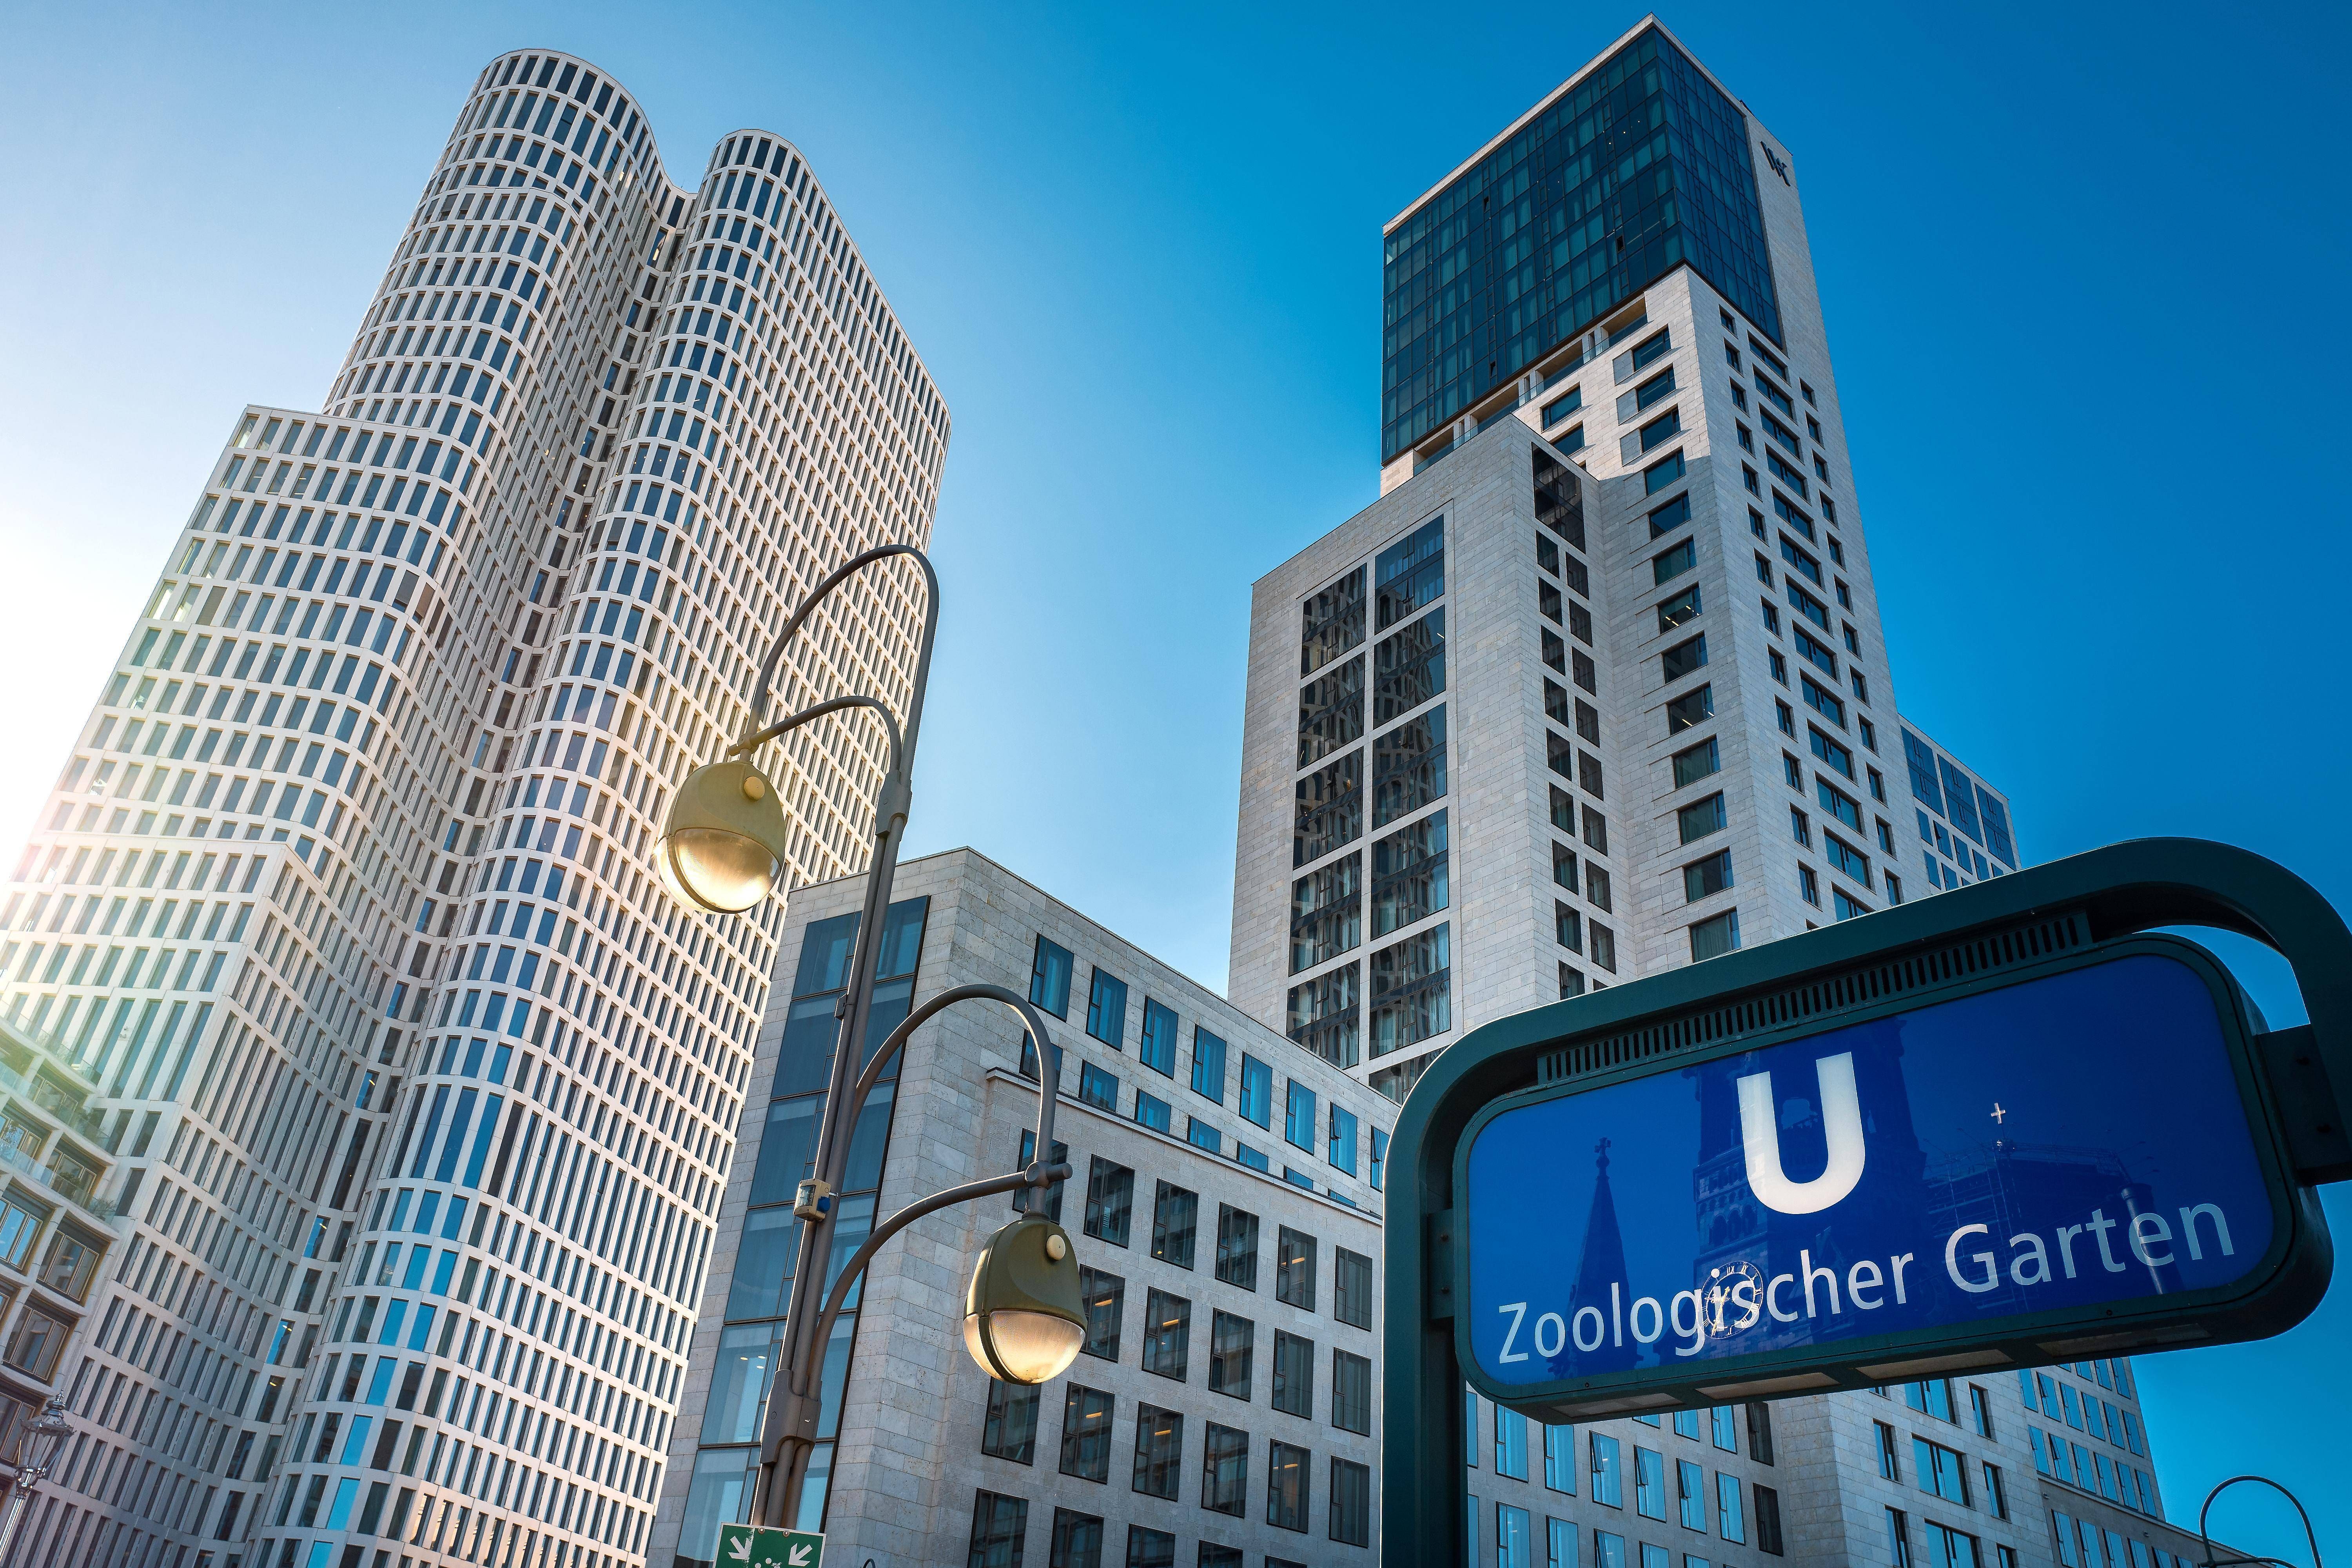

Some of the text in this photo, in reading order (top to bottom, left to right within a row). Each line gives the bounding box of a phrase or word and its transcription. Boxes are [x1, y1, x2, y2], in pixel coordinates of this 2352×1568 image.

[1737, 1051, 1866, 1214] U
[1499, 1202, 2235, 1364] Zoologischer Garten
